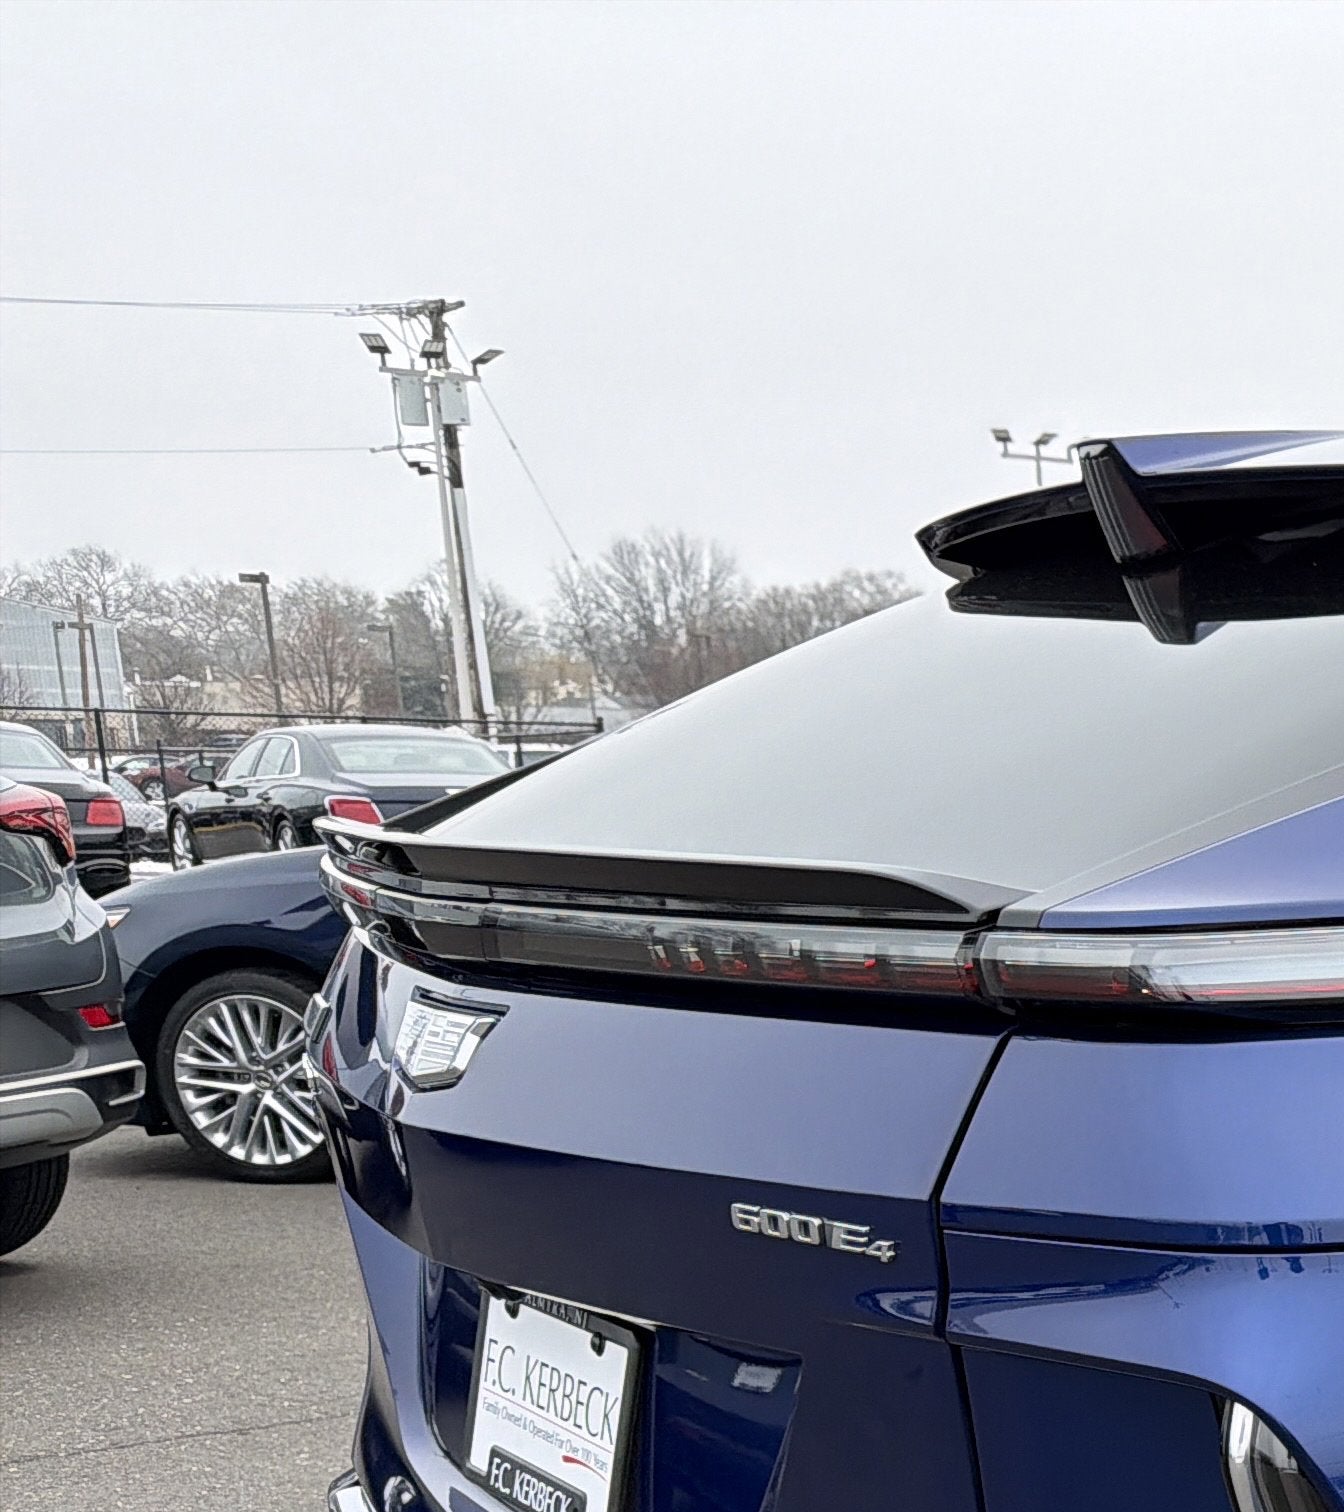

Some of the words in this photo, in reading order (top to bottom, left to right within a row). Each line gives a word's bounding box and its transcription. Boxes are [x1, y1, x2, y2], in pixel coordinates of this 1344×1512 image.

[483, 1338, 516, 1396] F.C.
[522, 1354, 619, 1445] KERBECK
[482, 1396, 501, 1419] Family
[501, 1405, 522, 1428] Owned
[528, 1419, 554, 1444] Operated
[554, 1431, 565, 1449] For
[565, 1438, 580, 1456] Over
[593, 1452, 609, 1473] Years
[490, 1457, 511, 1495] F.C.
